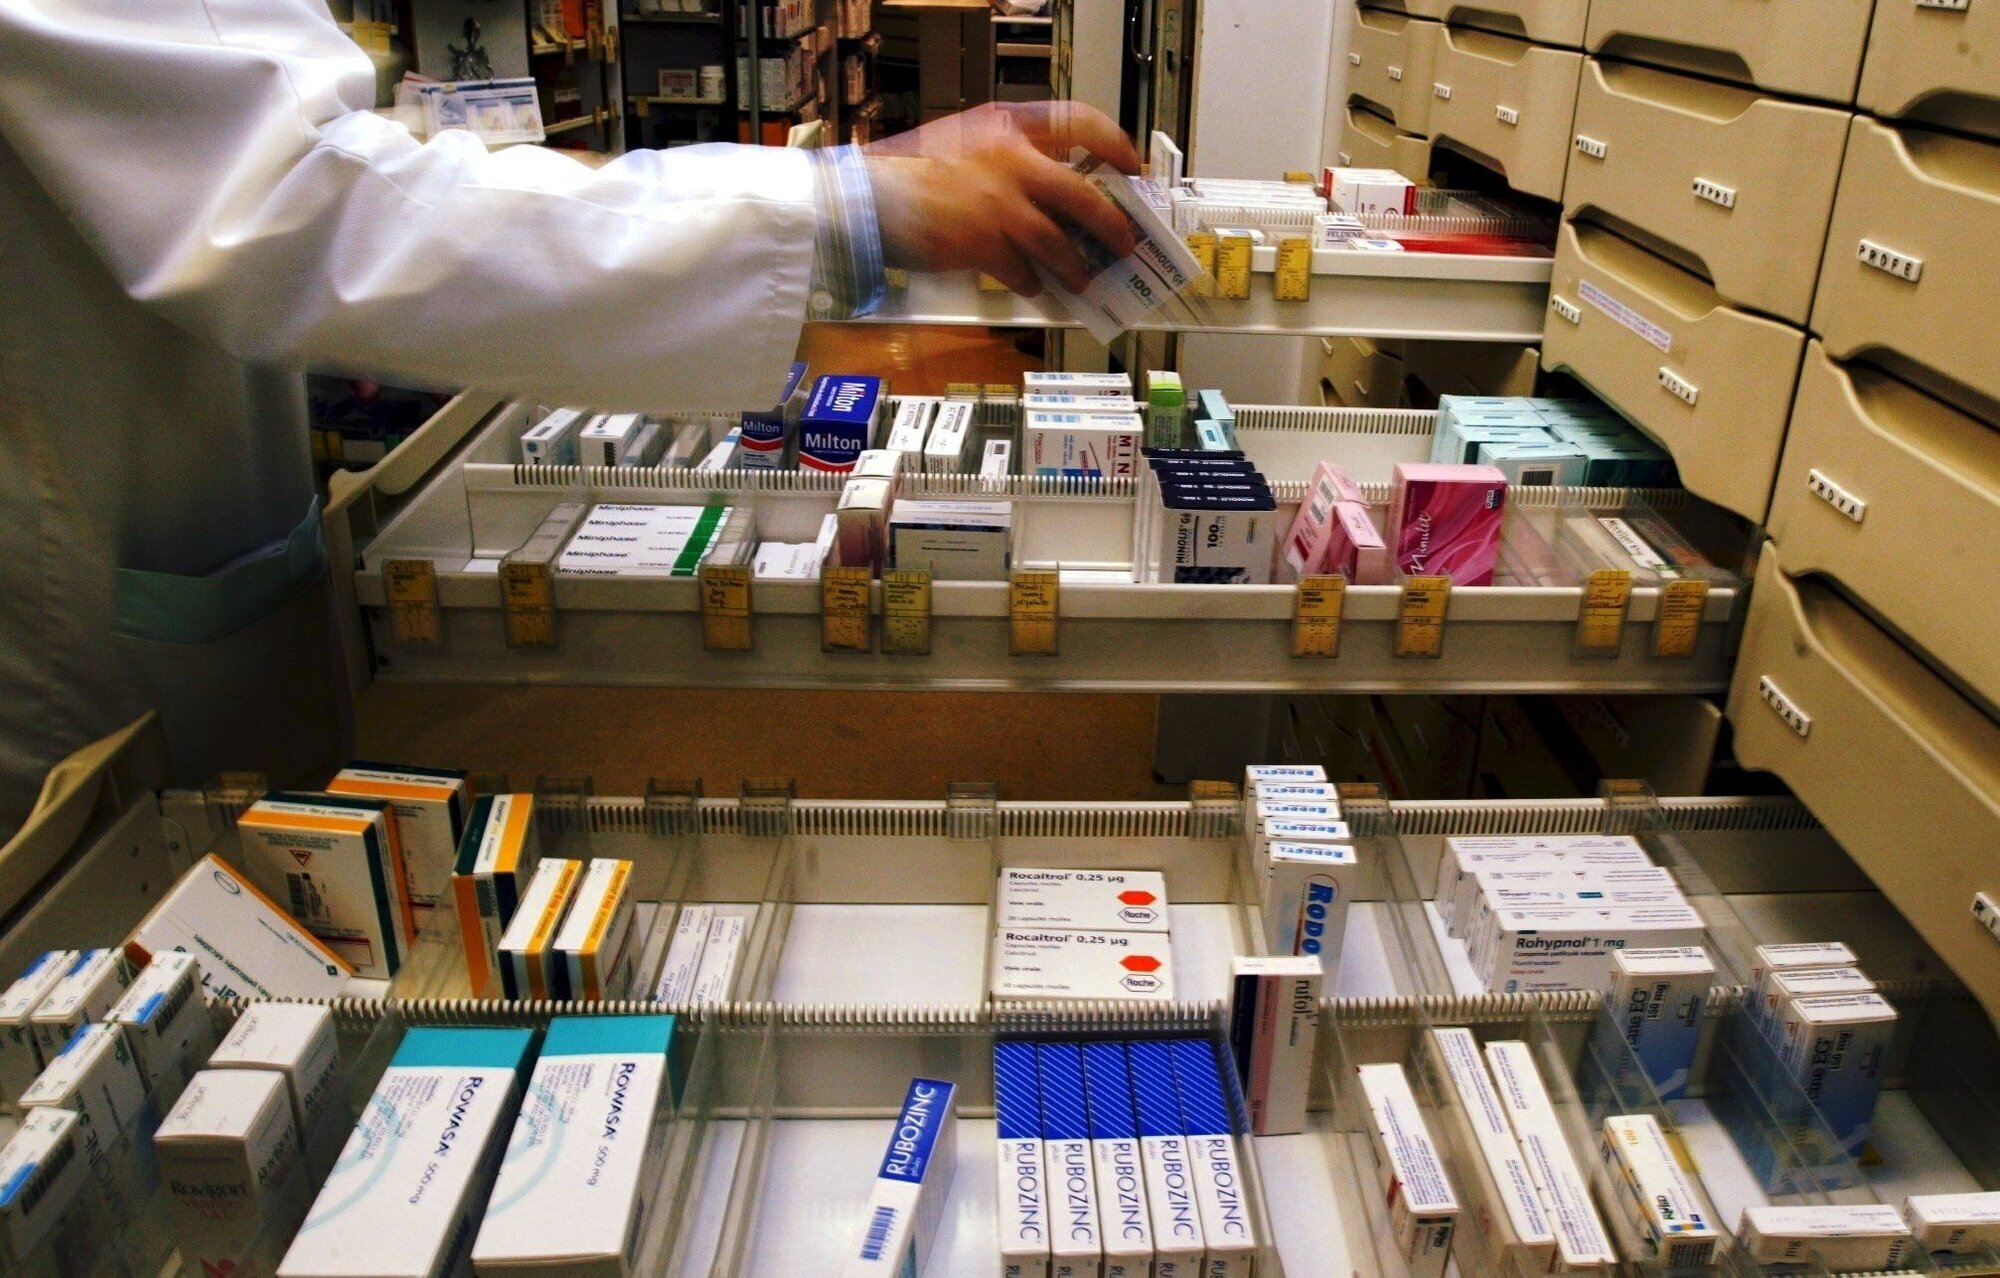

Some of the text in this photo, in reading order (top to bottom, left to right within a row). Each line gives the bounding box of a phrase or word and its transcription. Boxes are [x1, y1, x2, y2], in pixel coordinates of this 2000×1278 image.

[1128, 273, 1152, 298] 100
[832, 382, 867, 412] Milton
[743, 420, 780, 433] Milton
[805, 432, 862, 450] Milton
[598, 504, 657, 512] Miniphase
[587, 519, 648, 527] Miniphase
[576, 534, 639, 542] Miniphase
[1207, 523, 1220, 549] 100
[565, 549, 629, 558] Miniphase
[1009, 871, 1069, 881] Rocaltrol
[1076, 873, 1104, 882] 0.25
[1124, 910, 1152, 919] Roche
[1005, 932, 1069, 943] Rocaltrol
[1076, 935, 1106, 944] 0.25
[1516, 937, 1587, 951] Rohypnol
[1603, 938, 1626, 950] mg
[1126, 977, 1155, 987] Roche
[434, 1075, 484, 1155] ROWASA
[586, 1061, 637, 1188] ROWASA 500 mg
[885, 1084, 935, 1177] RUBOZINC
[421, 1161, 438, 1184] 500
[408, 1183, 425, 1205] mg
[1015, 1141, 1041, 1241] RUBOZINC
[1063, 1142, 1092, 1242] RUBOZINC
[1110, 1141, 1145, 1241] RUBOZINC
[1158, 1138, 1194, 1238] RUBOZINC
[1206, 1137, 1246, 1236] RUBOZINC
